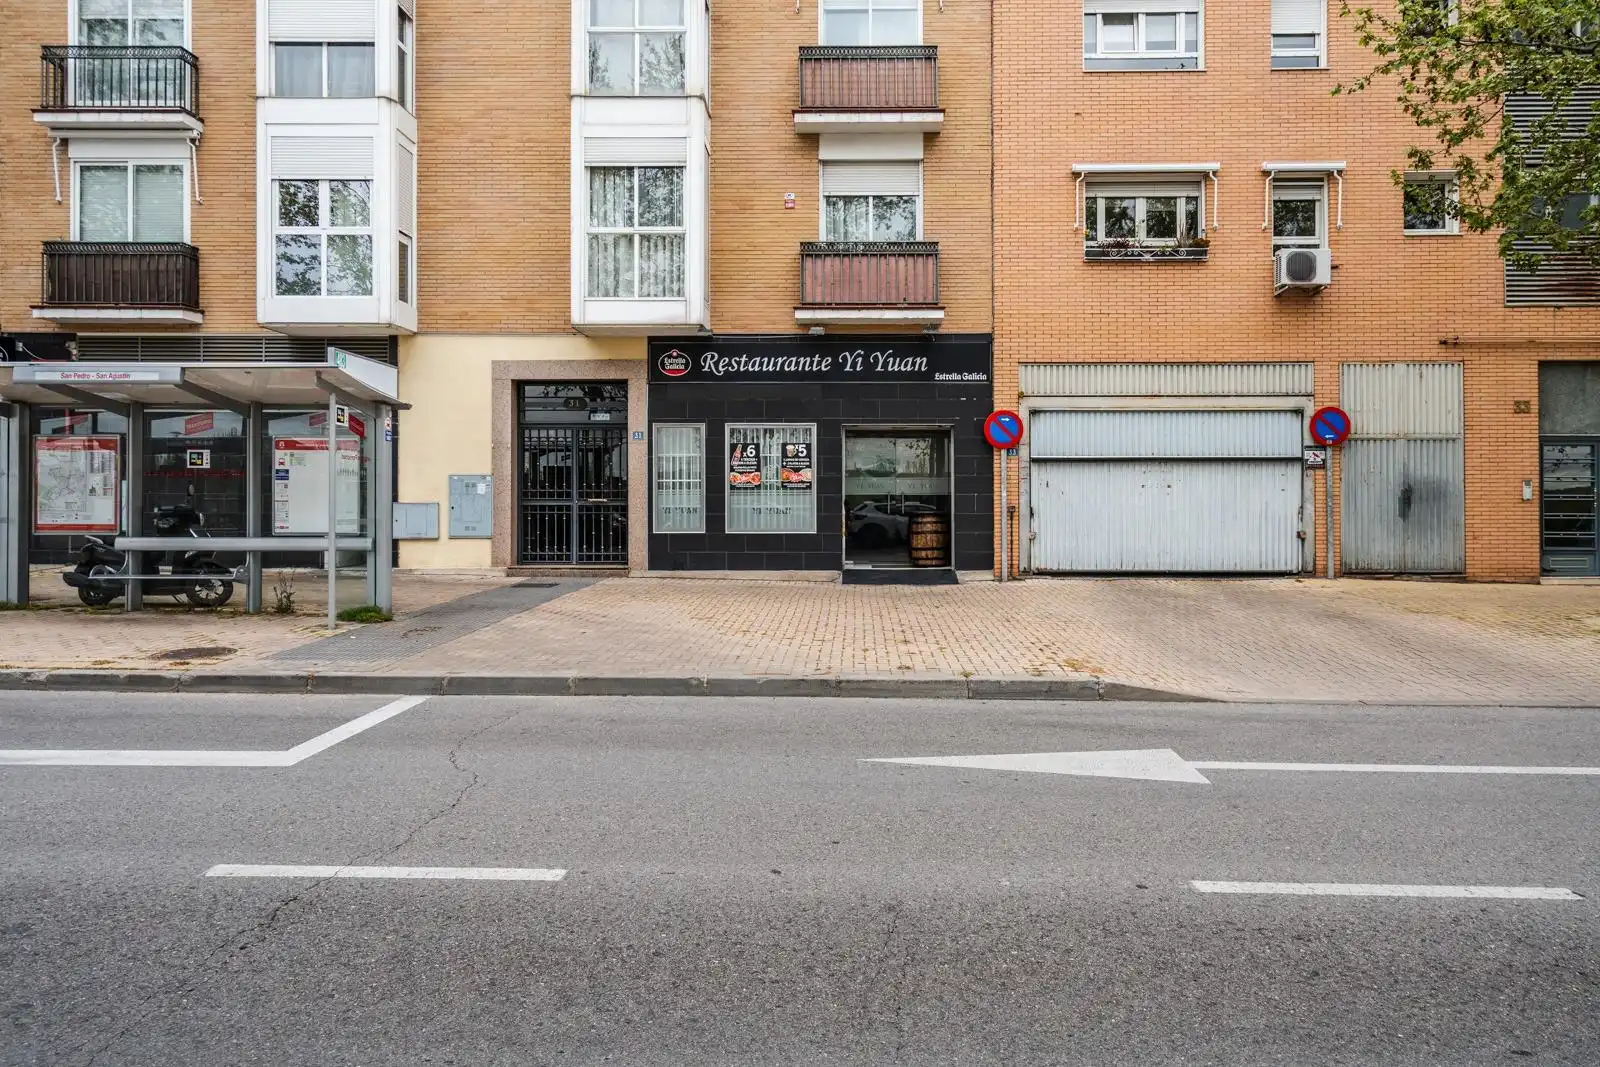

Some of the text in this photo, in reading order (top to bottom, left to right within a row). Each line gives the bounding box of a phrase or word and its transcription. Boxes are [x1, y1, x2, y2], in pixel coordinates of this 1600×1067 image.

[701, 350, 928, 376] Restaurante Yi Yuan
[568, 399, 579, 407] 31
